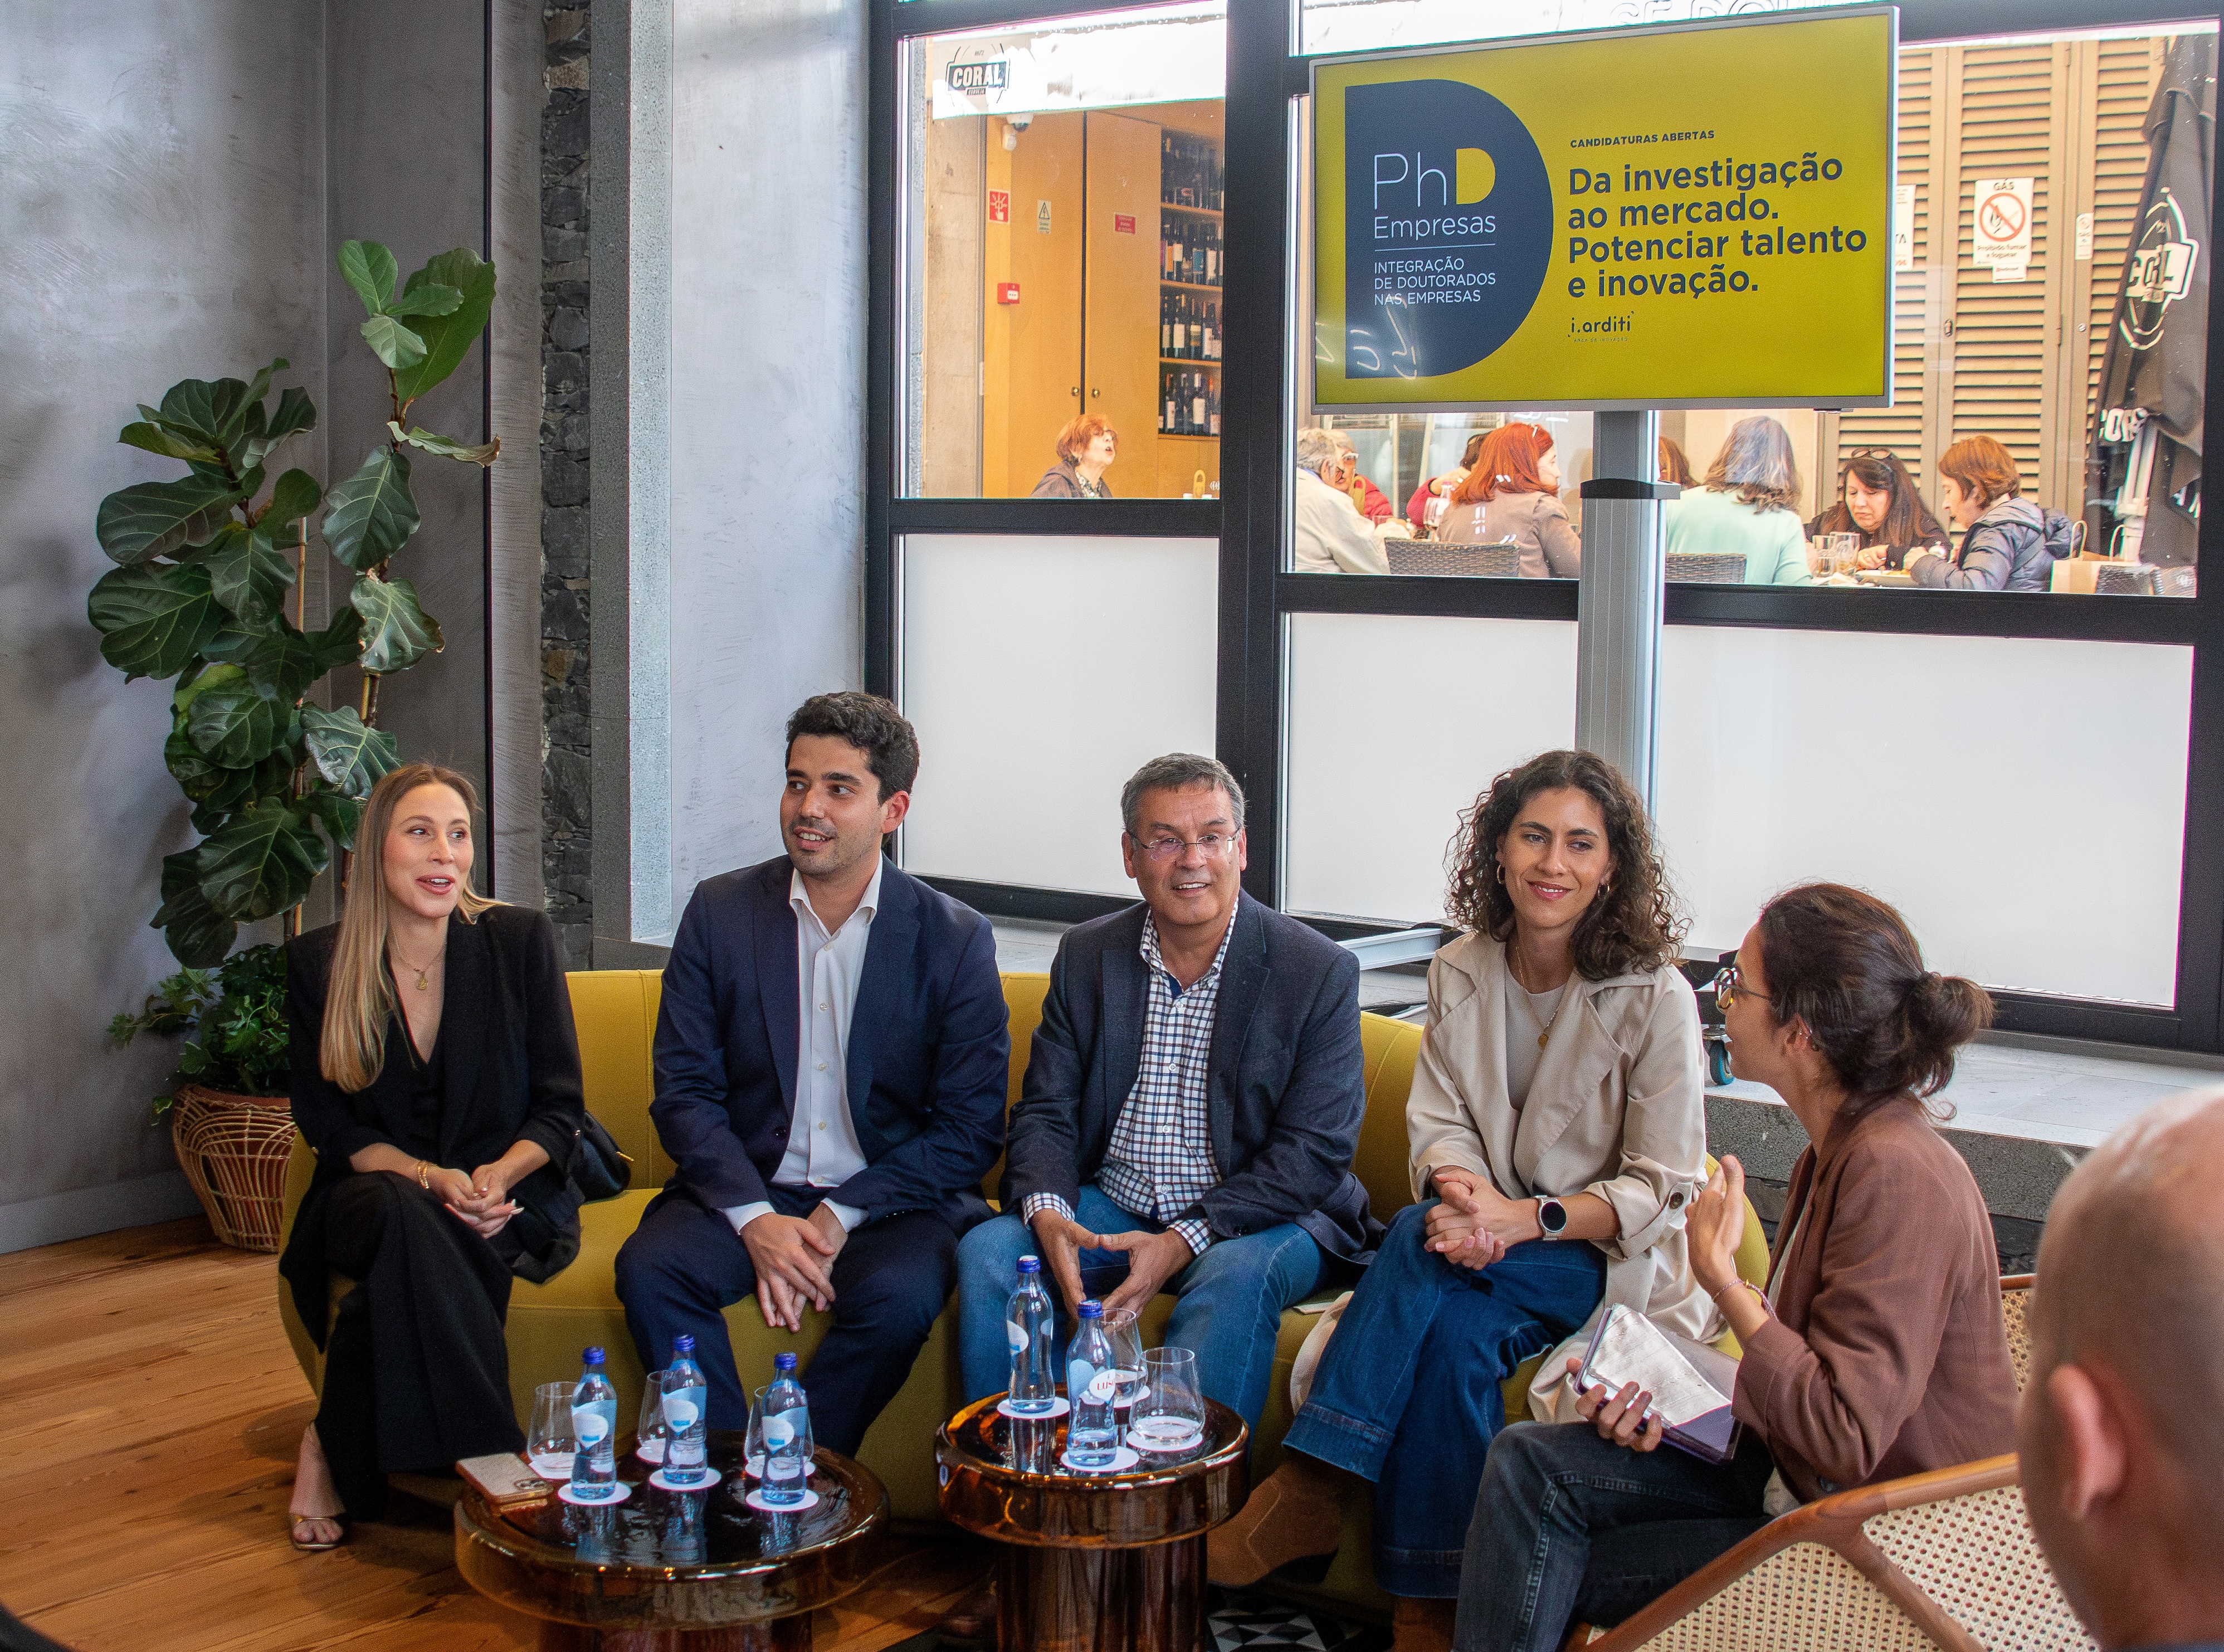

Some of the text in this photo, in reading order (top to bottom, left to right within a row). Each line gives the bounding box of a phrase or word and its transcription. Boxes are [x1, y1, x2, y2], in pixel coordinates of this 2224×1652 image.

[952, 64, 1003, 89] CORAL
[1570, 130, 1714, 148] CANDIDATURAS ABERTAS
[1374, 147, 1496, 210] PhD
[1569, 152, 1843, 195] Da investigação
[1993, 178, 2015, 191] GÁS
[1568, 192, 1778, 230] ao mercado.
[1374, 215, 1496, 241] Empresas
[1569, 226, 1867, 264] Potenciar talento
[1374, 256, 1464, 274] INTEGRAÇÃO
[1374, 272, 1496, 290] DE DOUTORADOS
[1568, 264, 1758, 299] e inovação.
[1374, 290, 1481, 306] NAS EMPRESAS
